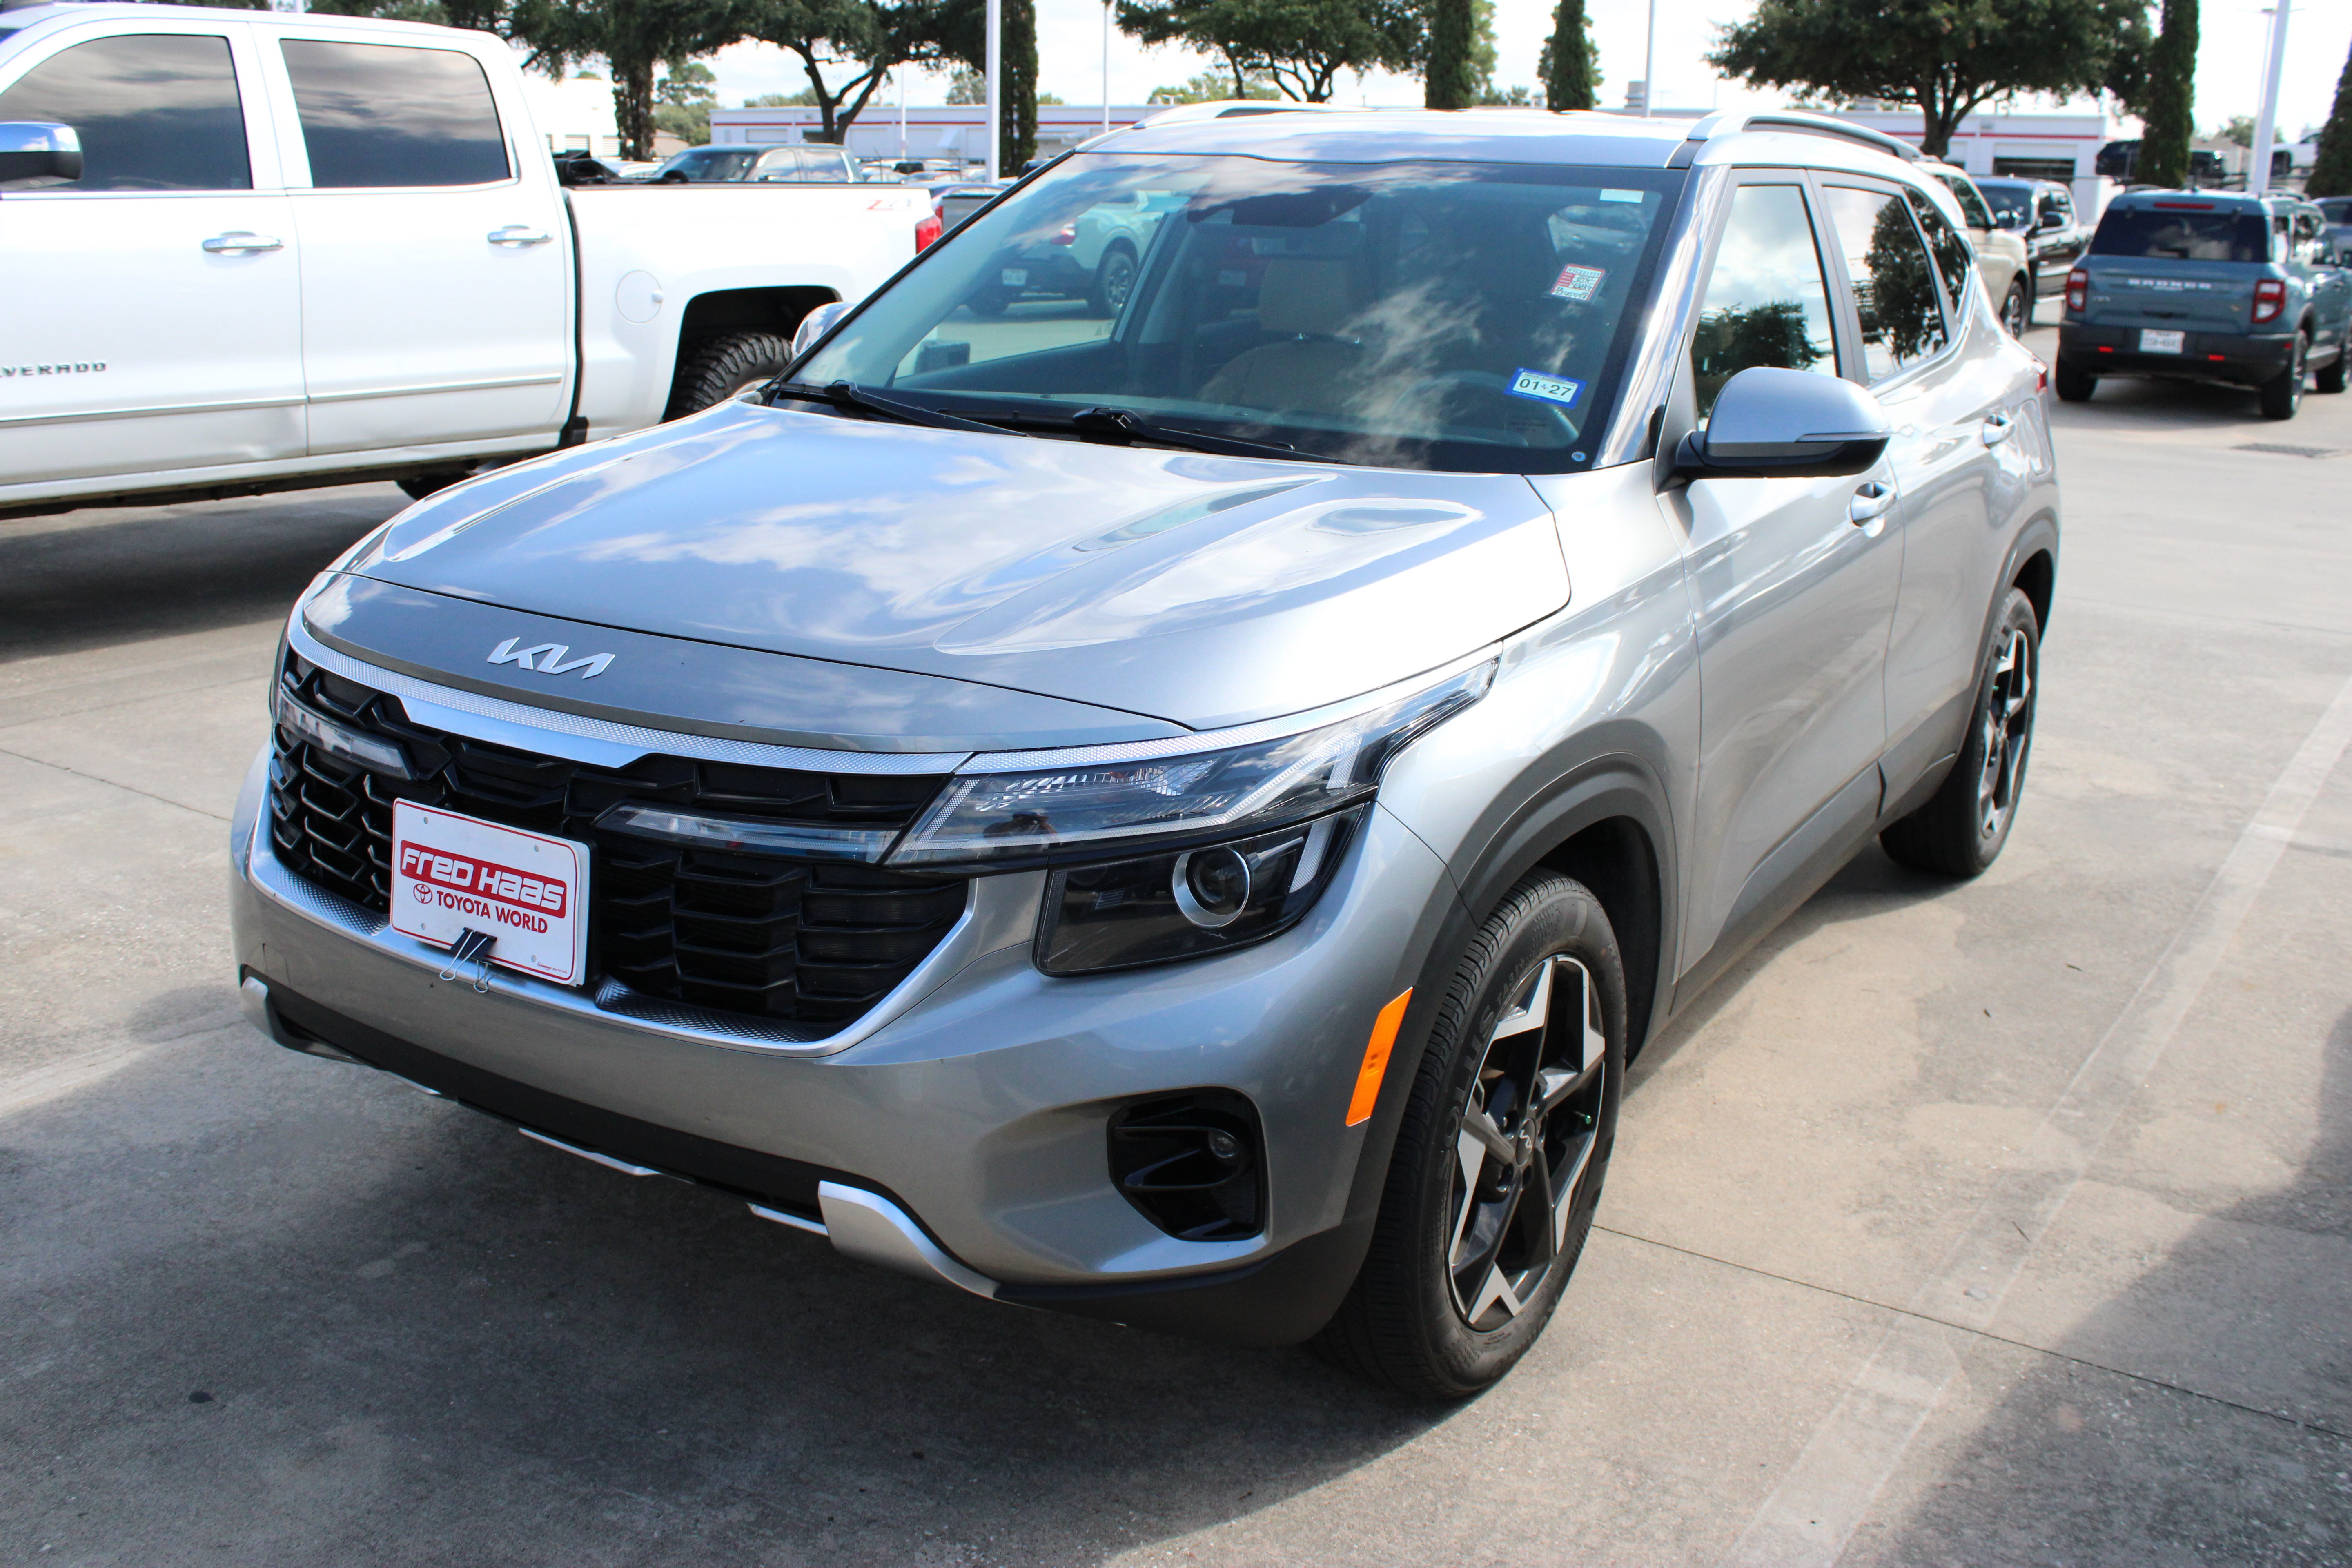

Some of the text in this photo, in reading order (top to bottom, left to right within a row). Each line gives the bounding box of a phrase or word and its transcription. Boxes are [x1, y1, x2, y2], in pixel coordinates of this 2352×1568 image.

[0, 361, 107, 377] VERADO
[1519, 374, 1540, 390] 01
[1548, 384, 1572, 396] 27
[487, 637, 616, 680] KIA
[437, 891, 548, 934] TOYOTA WORLD
[1437, 1004, 1494, 1184] SOLUS
